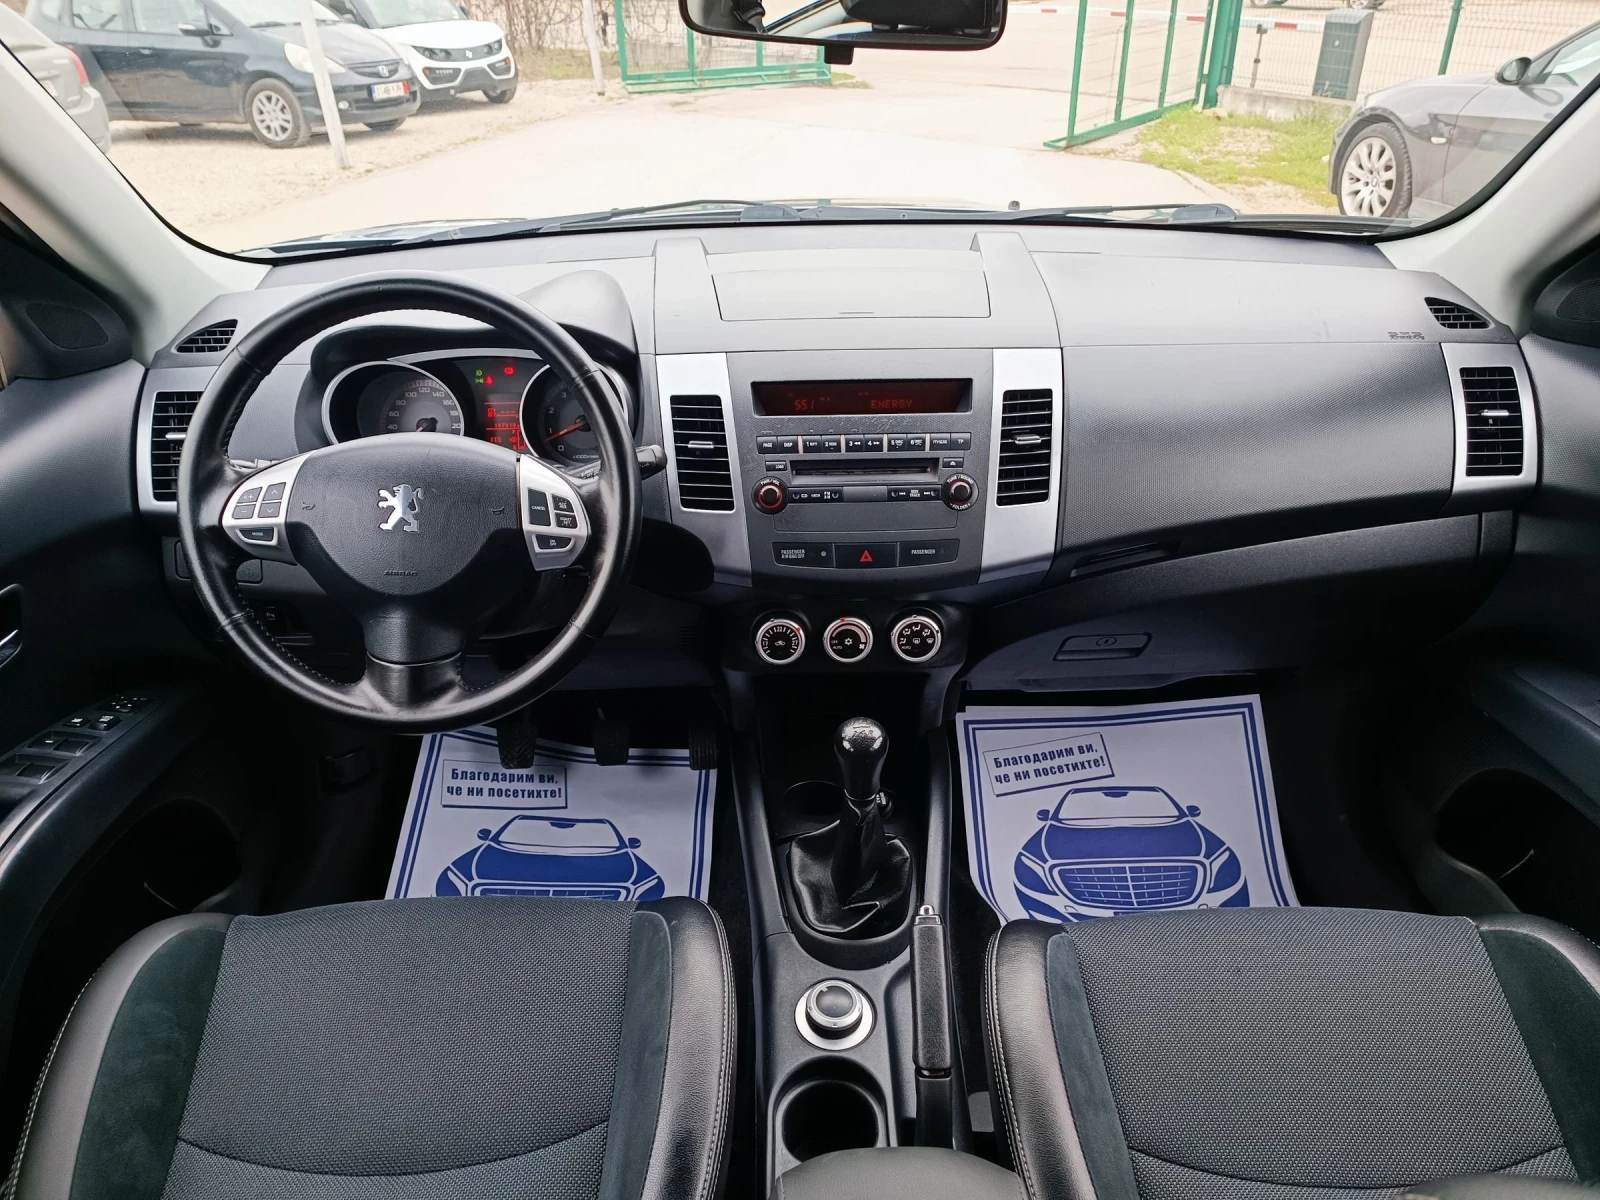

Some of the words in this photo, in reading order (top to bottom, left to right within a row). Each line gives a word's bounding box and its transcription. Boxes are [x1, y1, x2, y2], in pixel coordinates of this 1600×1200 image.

[871, 399, 913, 409] ENERGY
[993, 746, 1075, 768] Благодарим
[1077, 743, 1098, 755] ви,
[451, 768, 535, 784] Благодарим
[538, 773, 558, 785] ви,
[994, 773, 1011, 784] че
[1013, 770, 1031, 781] ни
[1033, 755, 1106, 778] посетихте!
[446, 785, 462, 796] че
[467, 786, 484, 797] ни
[488, 787, 562, 798] посетихте!
